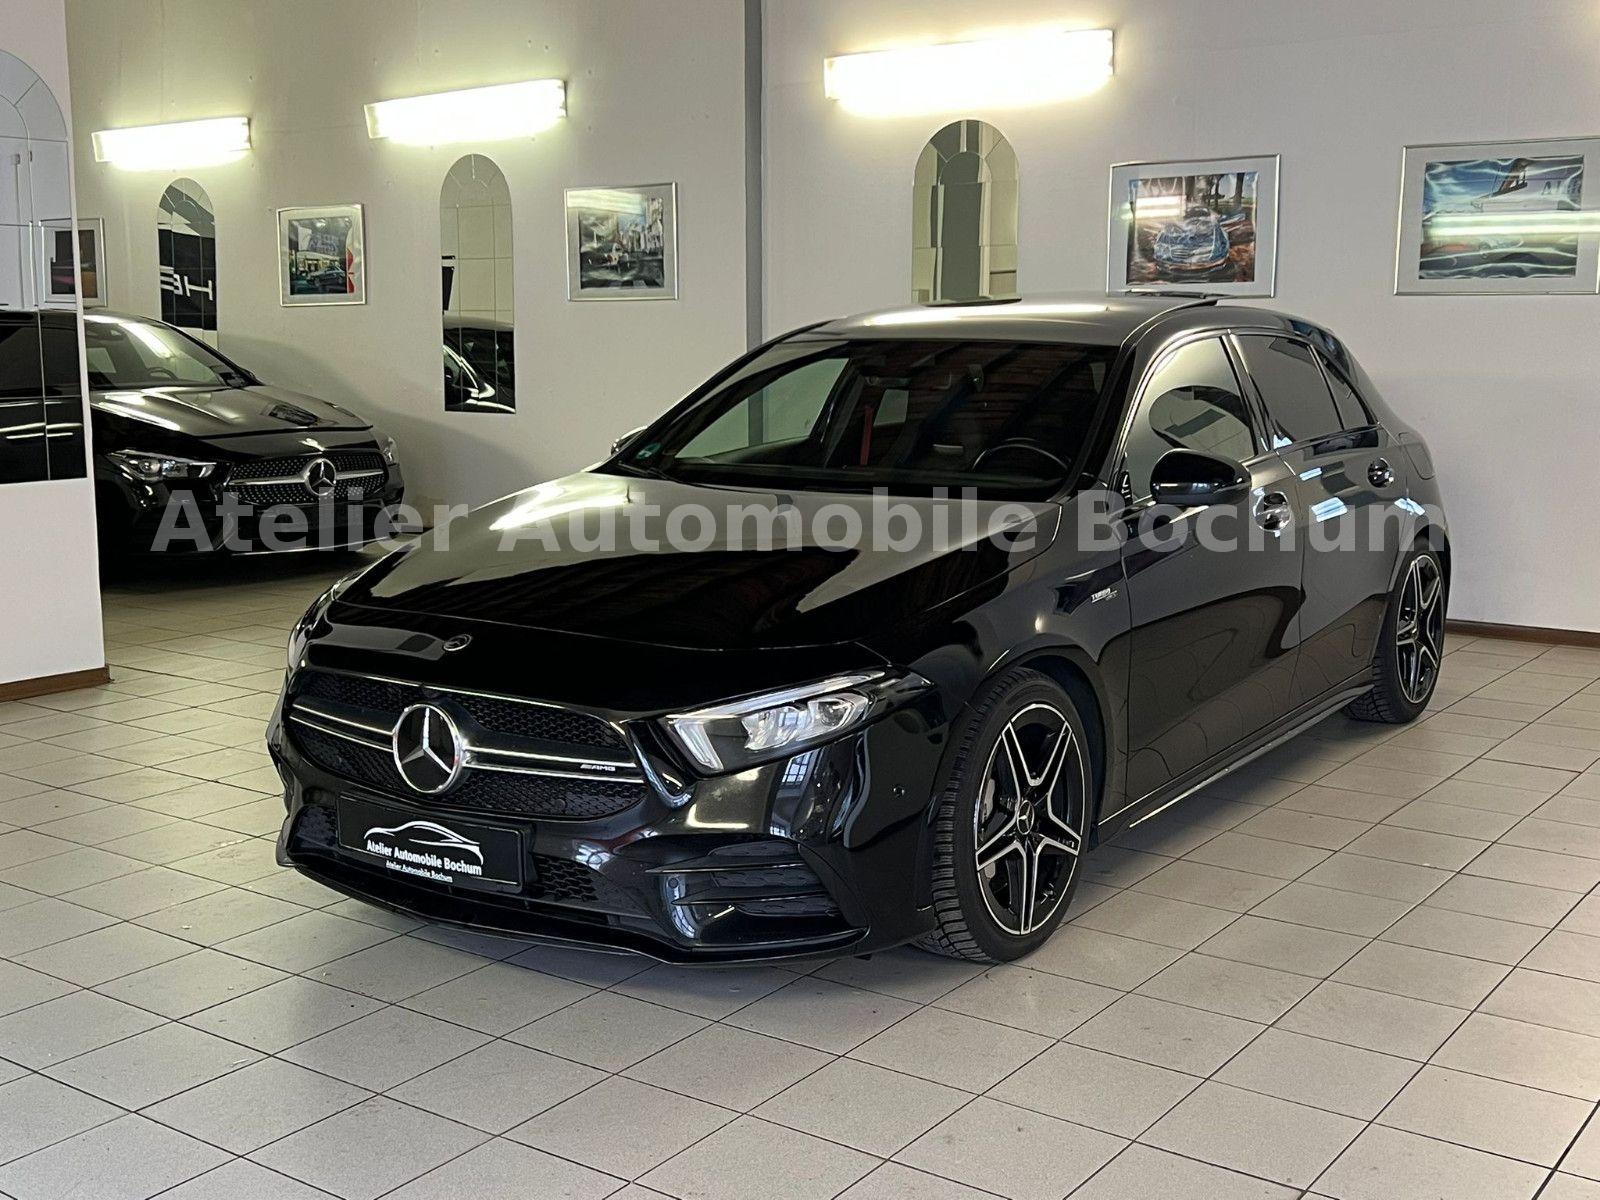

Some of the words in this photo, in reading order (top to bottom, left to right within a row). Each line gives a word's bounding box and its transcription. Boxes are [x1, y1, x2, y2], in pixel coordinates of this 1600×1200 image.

[366, 839, 392, 857] Atelier
[394, 846, 442, 869] Automobile
[444, 857, 482, 876] Bochum
[386, 860, 402, 872] Atelier
[402, 864, 431, 878] Automobile
[431, 870, 453, 883] Bochum
